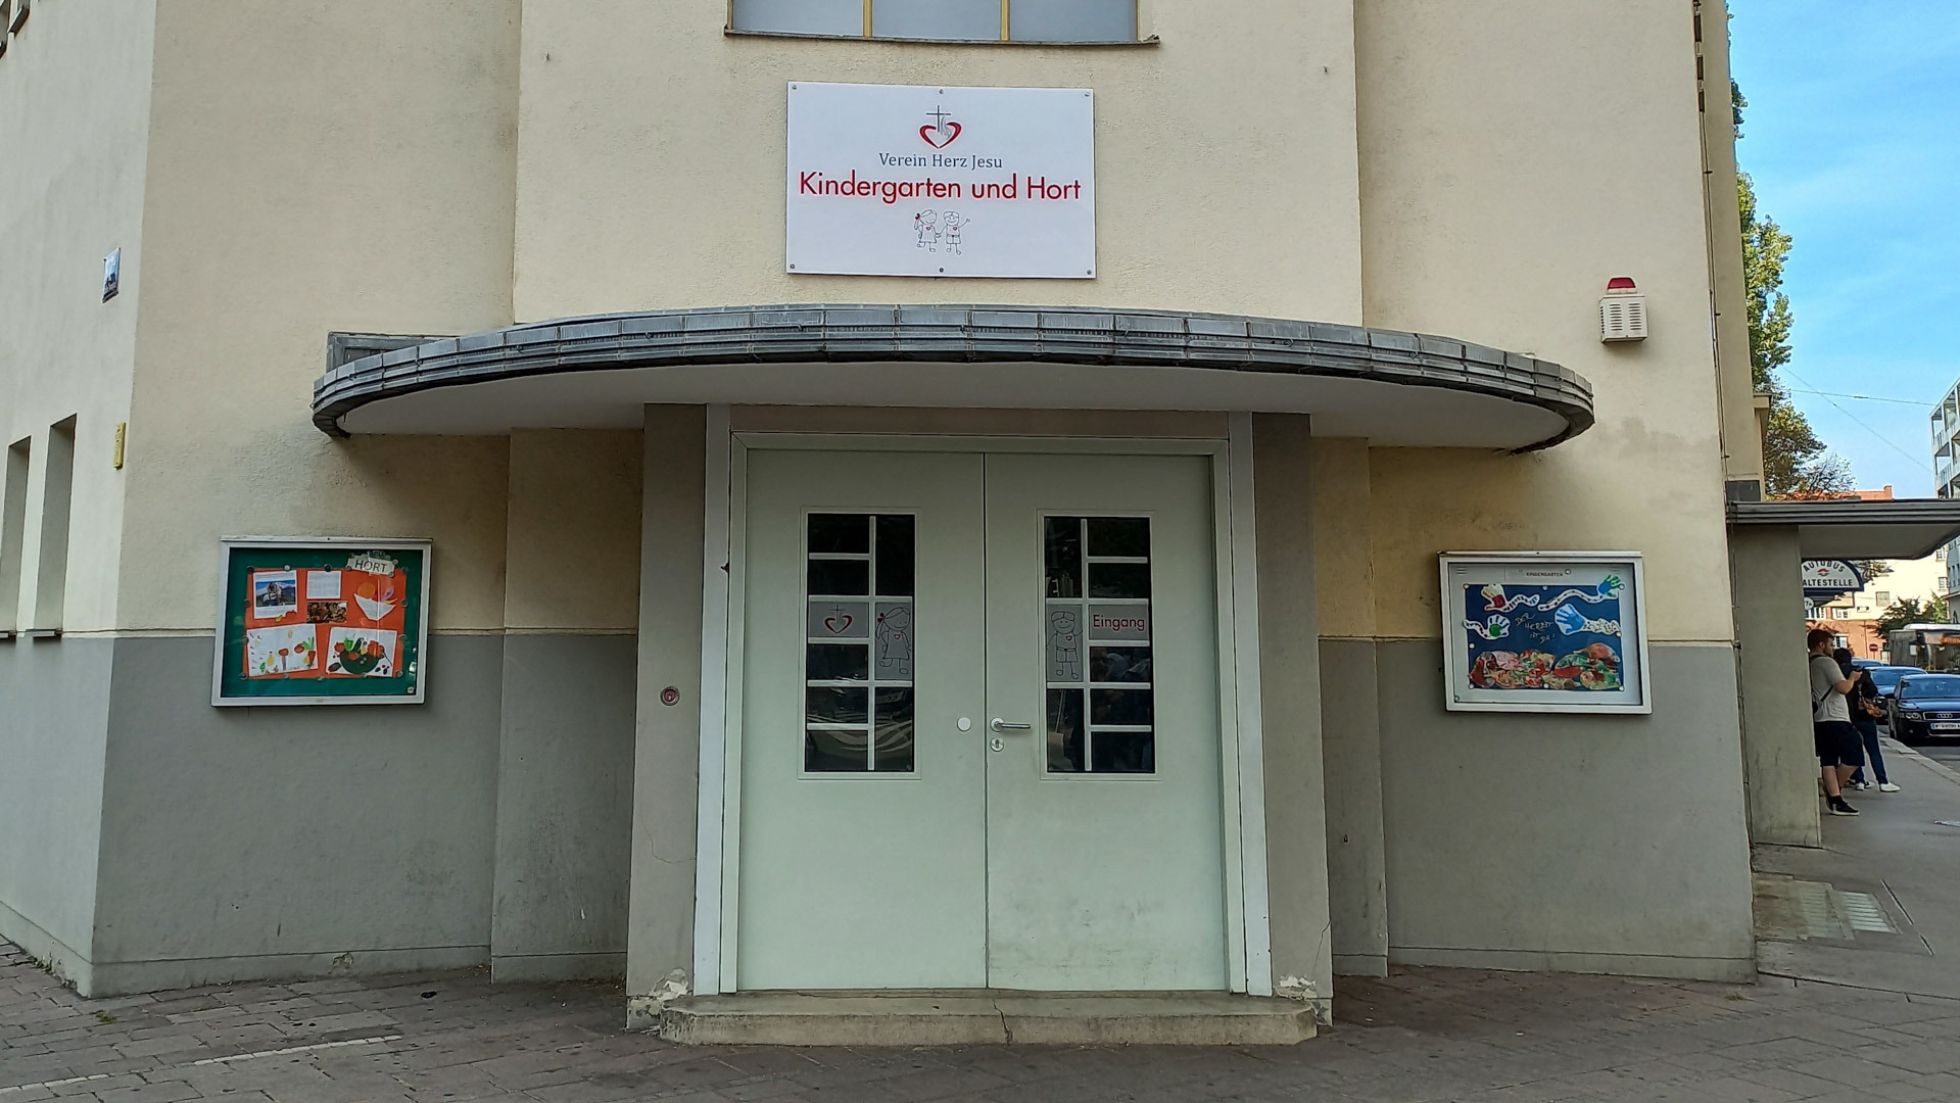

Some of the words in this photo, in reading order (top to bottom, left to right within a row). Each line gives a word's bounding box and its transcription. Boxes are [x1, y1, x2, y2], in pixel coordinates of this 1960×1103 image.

[879, 152, 927, 167] Verein
[932, 153, 968, 168] Herz
[971, 154, 1003, 171] Jesu
[799, 168, 961, 205] Kindergarten
[971, 172, 1017, 199] und
[1027, 175, 1081, 200] Hort
[355, 560, 387, 573] HORT
[1802, 560, 1846, 572] AUTOBUS
[1802, 579, 1853, 587] ALTESTELLE
[1093, 614, 1145, 631] Eingang
